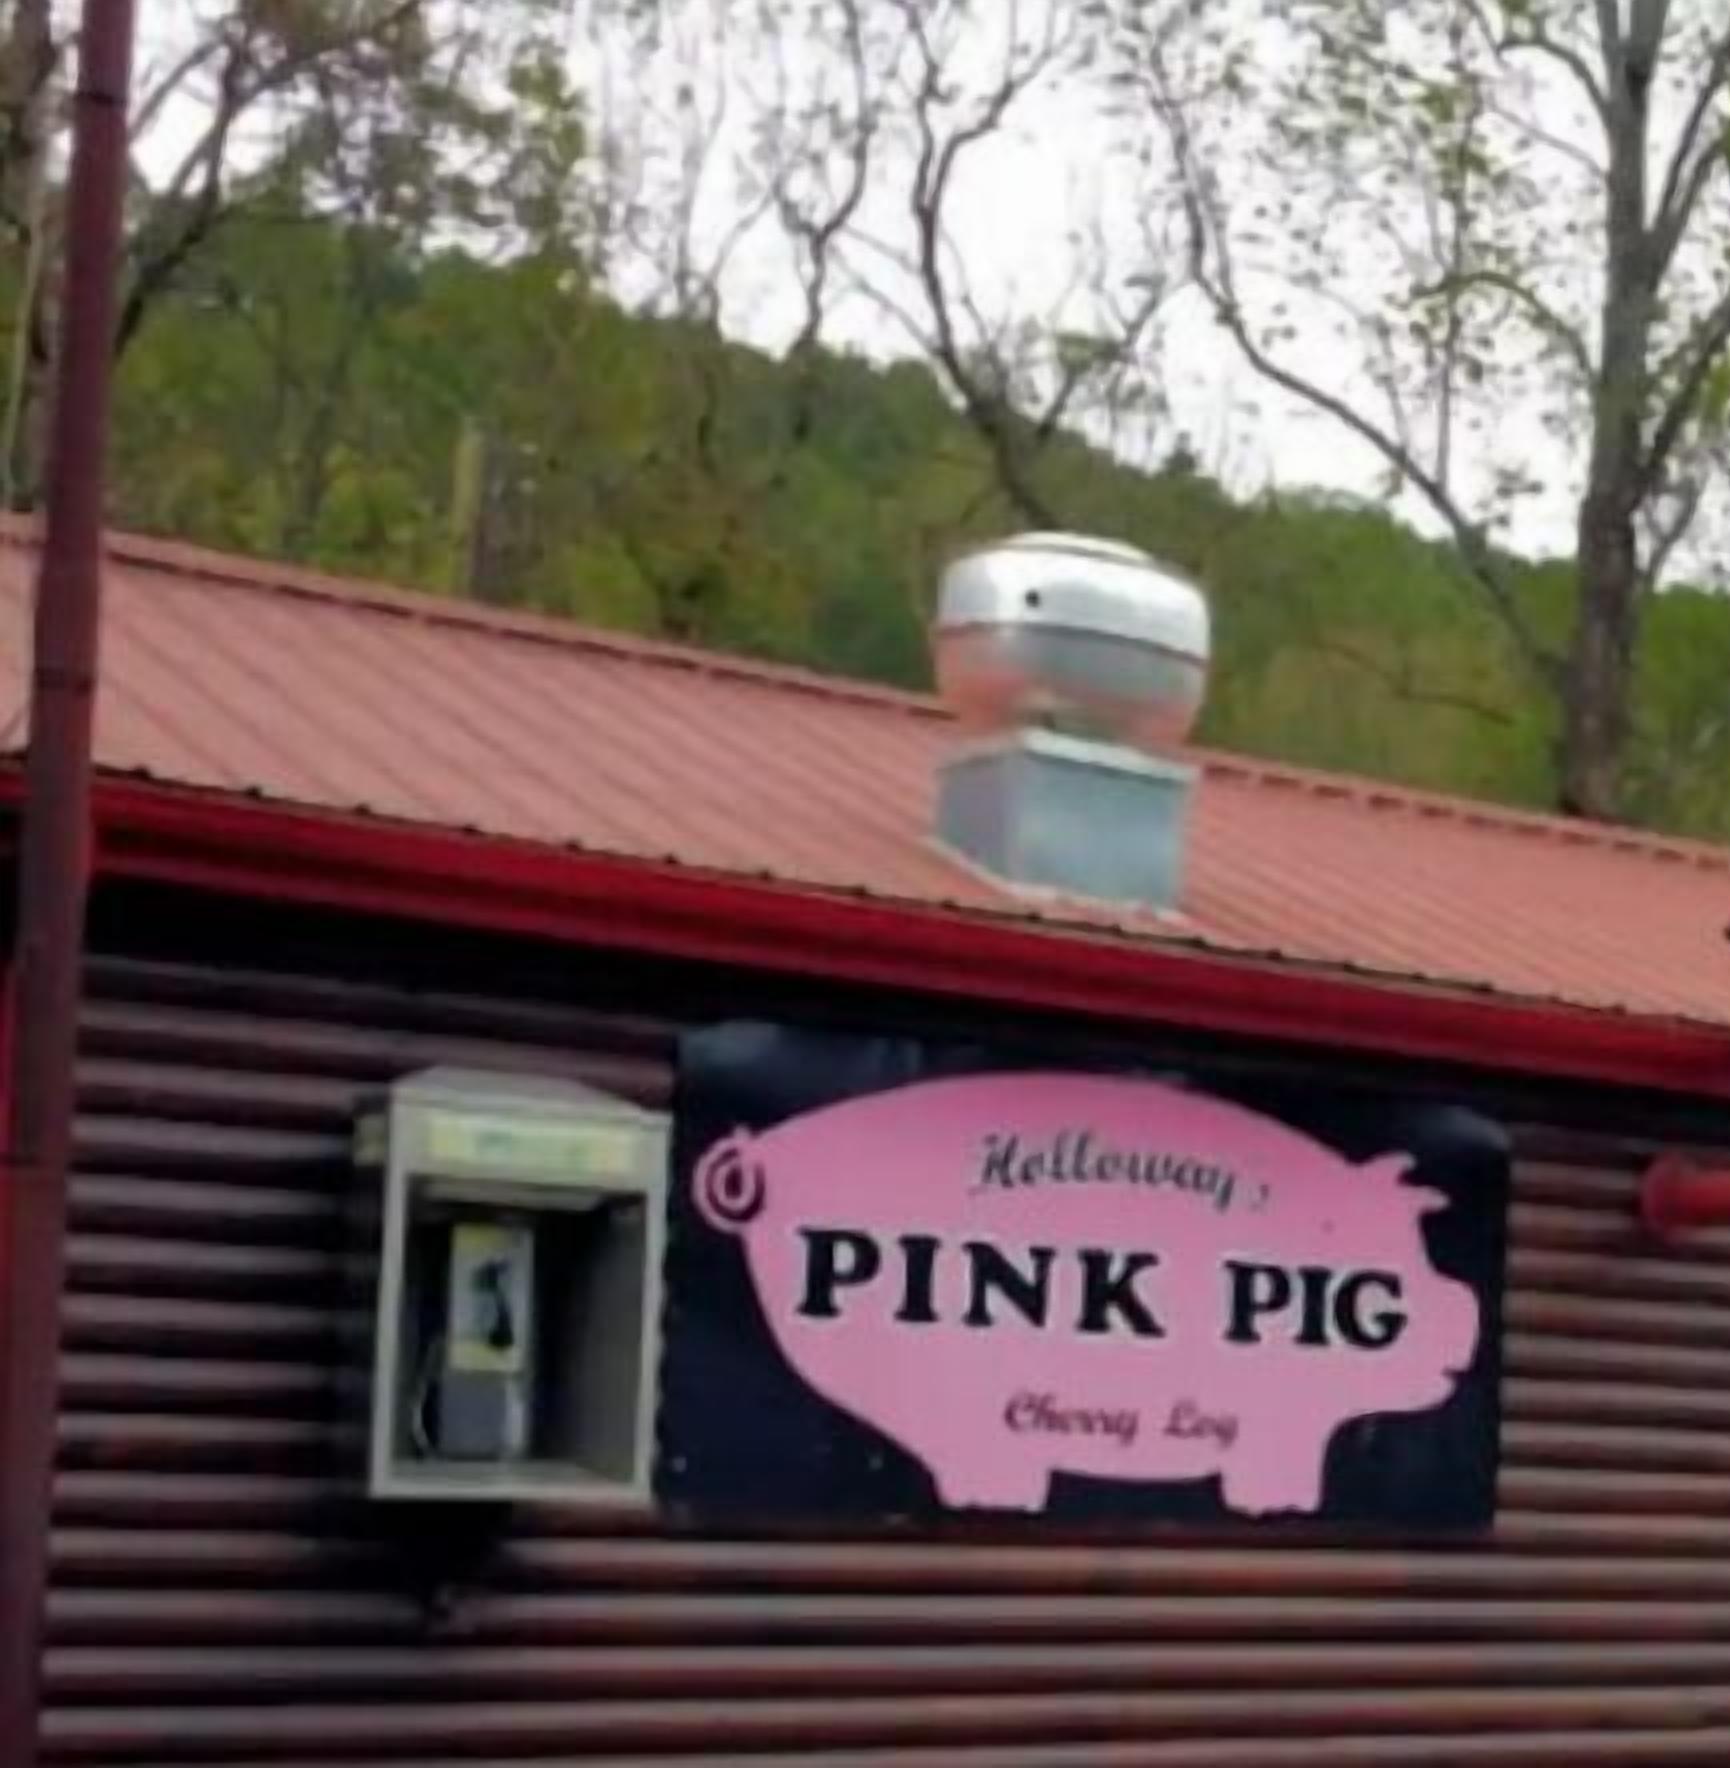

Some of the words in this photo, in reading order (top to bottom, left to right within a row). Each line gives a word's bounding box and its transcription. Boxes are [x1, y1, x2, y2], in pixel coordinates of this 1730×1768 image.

[970, 1132, 1268, 1212] Holloways
[797, 1227, 1165, 1340] PINK
[1222, 1258, 1408, 1350] PIG
[1003, 1390, 1140, 1447] Cherry
[1162, 1397, 1240, 1449] Log
